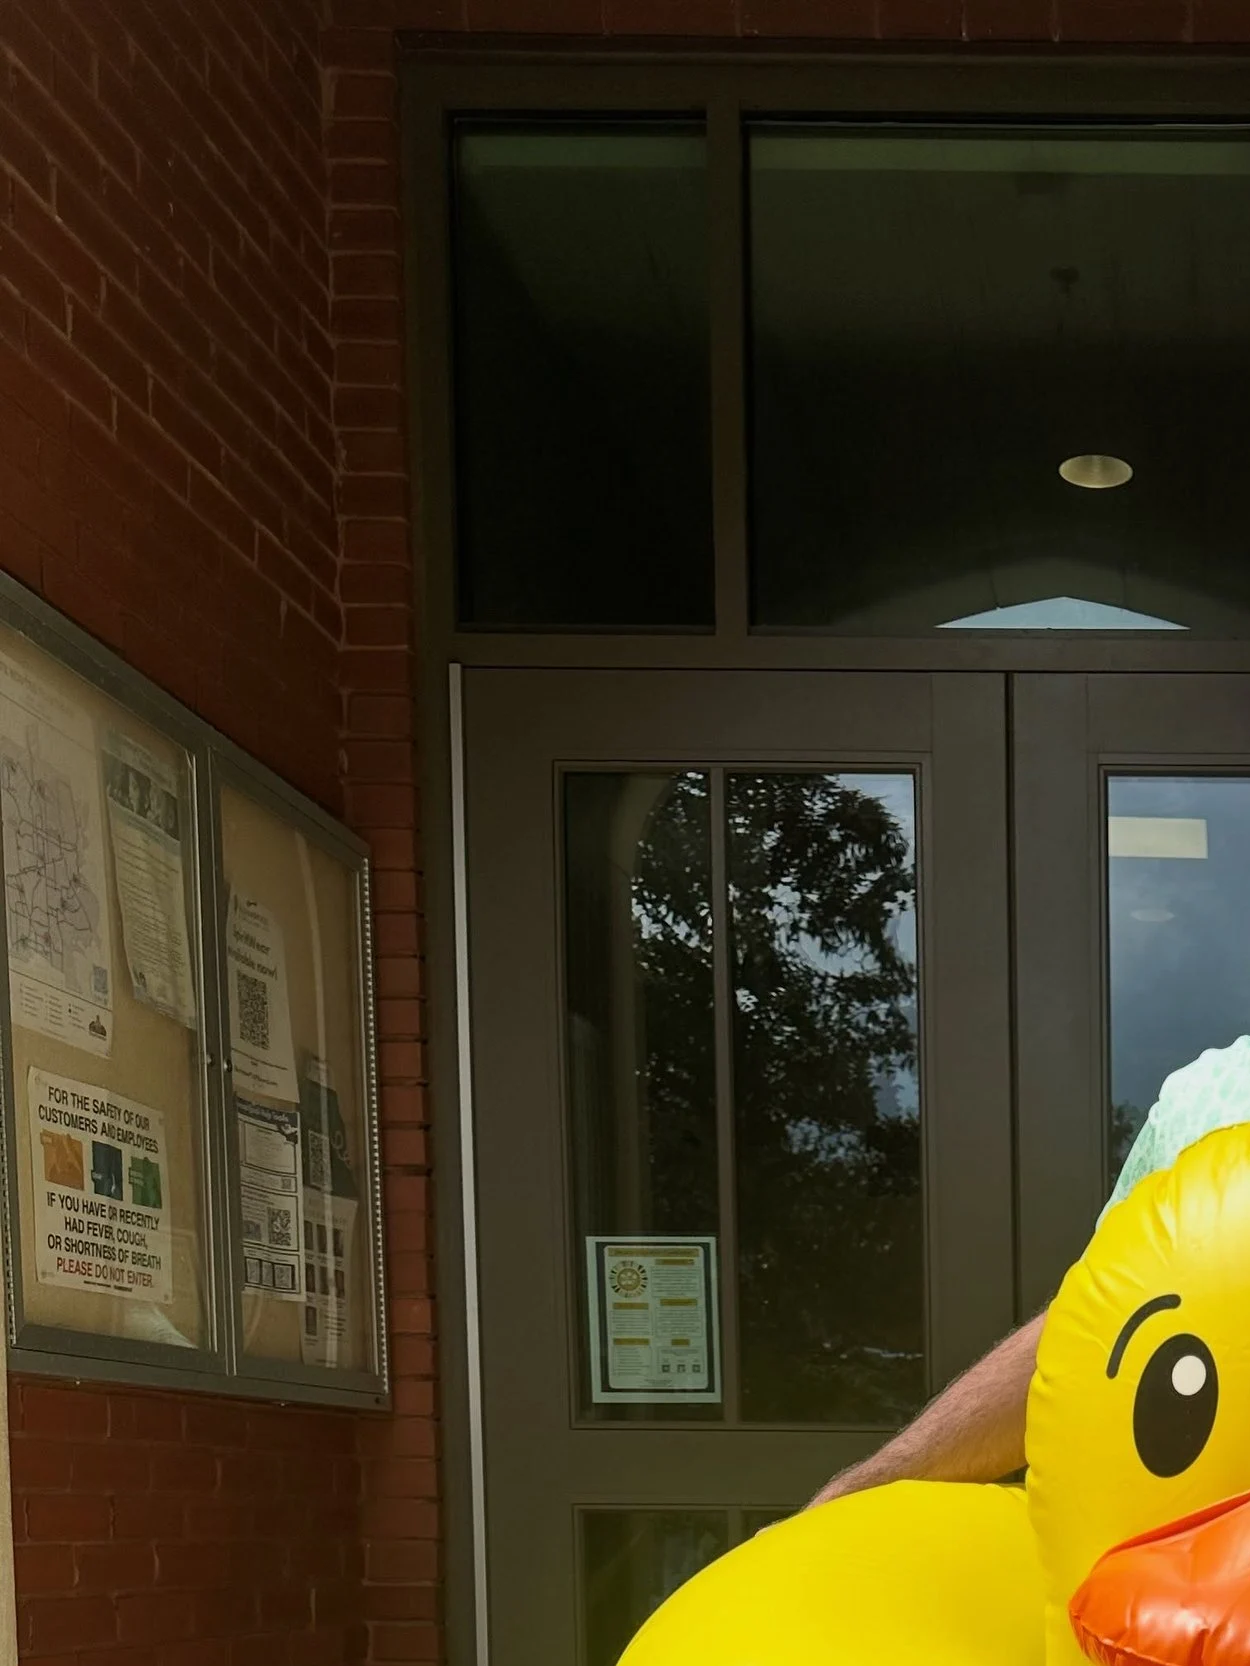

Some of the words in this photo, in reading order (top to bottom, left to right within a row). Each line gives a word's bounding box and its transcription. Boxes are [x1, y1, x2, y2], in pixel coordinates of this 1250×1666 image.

[48, 1086, 68, 1106] FOR
[70, 1092, 90, 1112] THE
[92, 1099, 122, 1122] SAFETY
[123, 1109, 134, 1125] OF
[135, 1114, 150, 1131] OUR
[38, 1104, 98, 1135] CUSTOMERS
[101, 1122, 115, 1140] AND
[117, 1127, 159, 1154] EMPLOYEES
[47, 1191, 56, 1207] IF
[58, 1193, 80, 1213] YOU
[82, 1199, 107, 1220] HAVE
[108, 1205, 118, 1221] OR
[119, 1209, 160, 1231] RECENTLY
[64, 1216, 84, 1234] HAD
[86, 1221, 115, 1244] FEVER,
[116, 1228, 148, 1249] COUGH,
[47, 1234, 62, 1251] OR
[64, 1237, 116, 1262] SHORTNESS
[118, 1248, 129, 1264] OF
[131, 1251, 161, 1271] BREATH
[56, 1257, 93, 1277] PLEASE
[95, 1264, 108, 1280] DO
[109, 1266, 125, 1283] NOT
